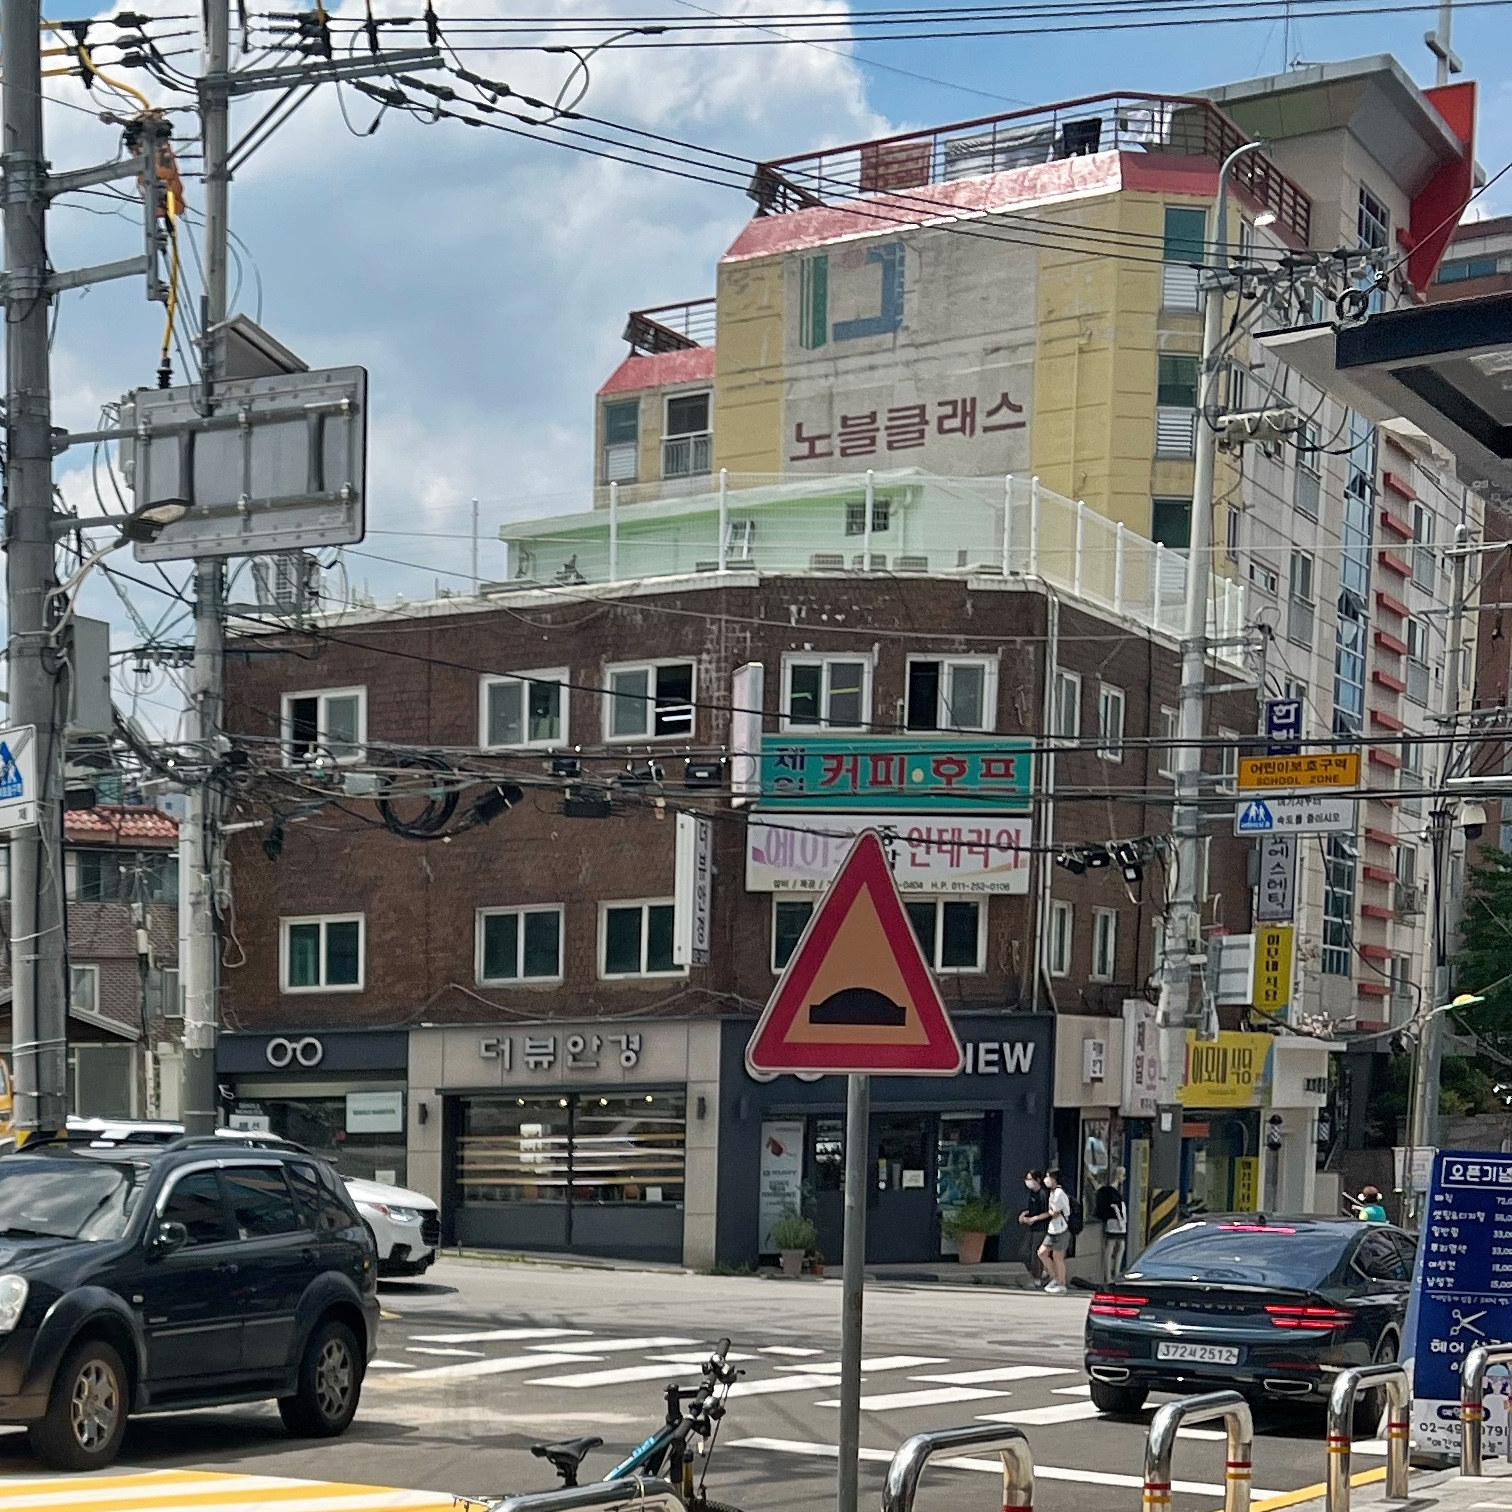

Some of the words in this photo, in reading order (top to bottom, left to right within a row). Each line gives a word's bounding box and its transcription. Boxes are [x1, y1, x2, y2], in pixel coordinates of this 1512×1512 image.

[790, 391, 1027, 461] 노블클래스
[821, 754, 906, 791] 커피
[930, 756, 1017, 792] 호프
[1249, 758, 1348, 775] 어린이보호구역
[1256, 776, 1302, 786] SCHOOL
[1309, 774, 1340, 784] ZONE
[906, 826, 1022, 870] 인테리어
[479, 1033, 642, 1071] 더뷰안경
[965, 1041, 1036, 1075] IEW
